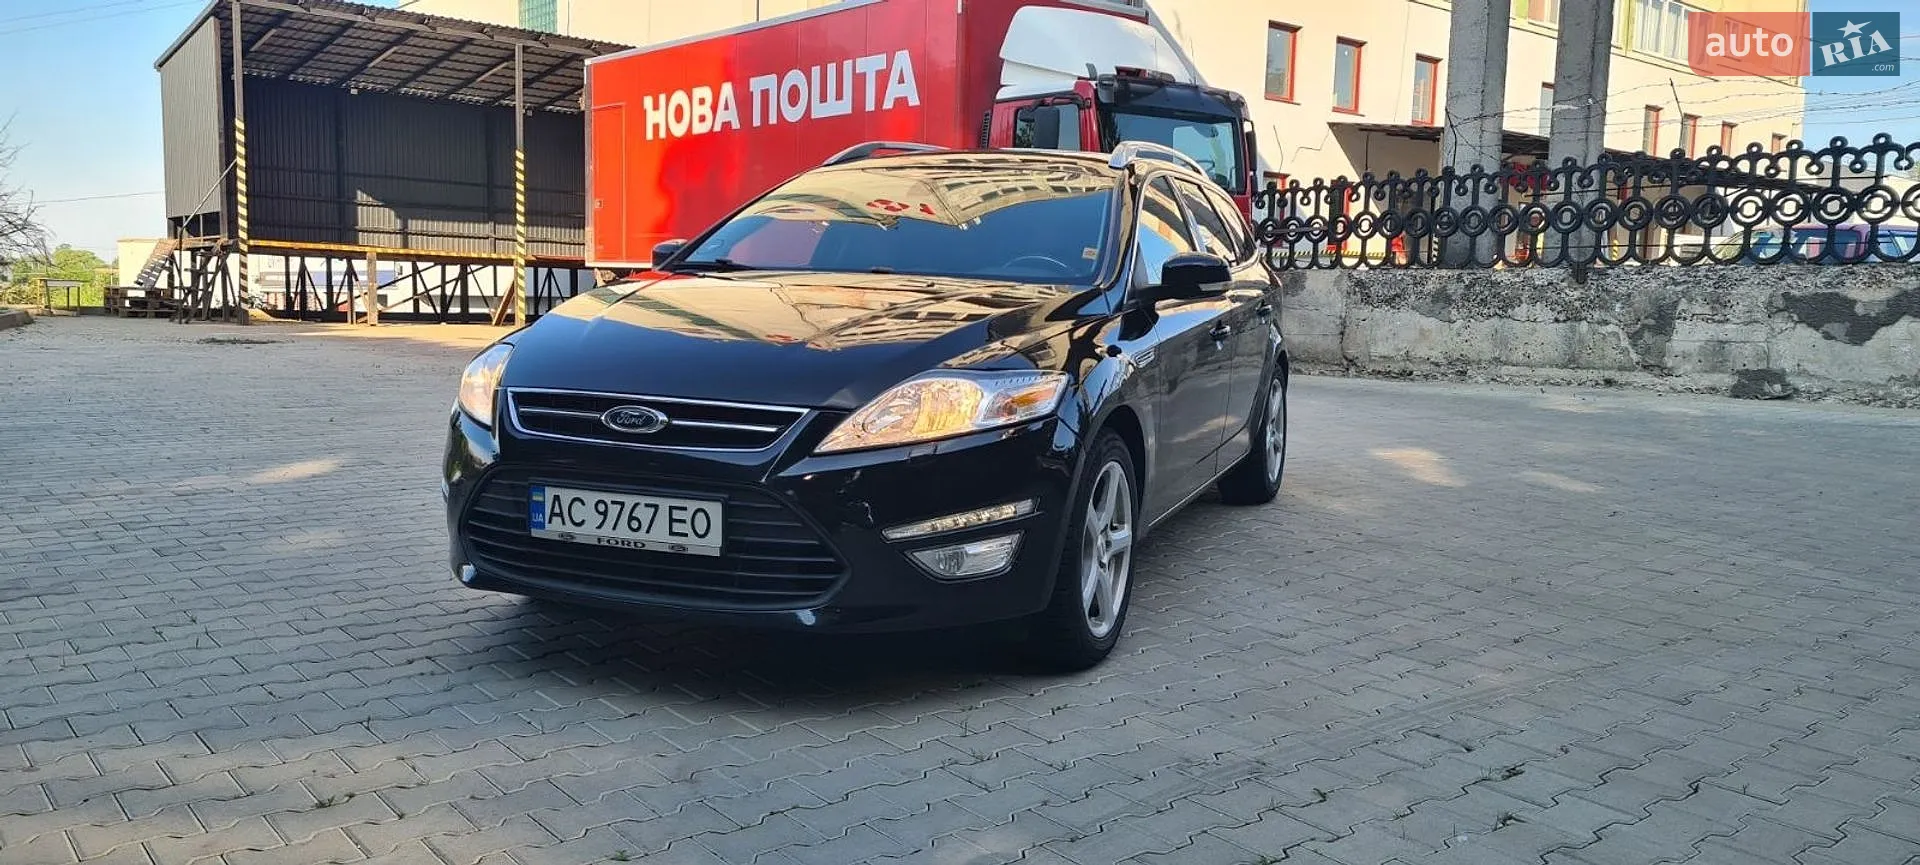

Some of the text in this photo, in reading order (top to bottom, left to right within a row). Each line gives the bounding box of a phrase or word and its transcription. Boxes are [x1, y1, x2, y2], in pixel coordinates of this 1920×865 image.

[643, 49, 921, 141] НОВА ПОШТА
[616, 409, 648, 426] Ford
[532, 514, 544, 523] UA
[548, 494, 711, 539] AC 9767 EO
[597, 537, 646, 549] FORD
